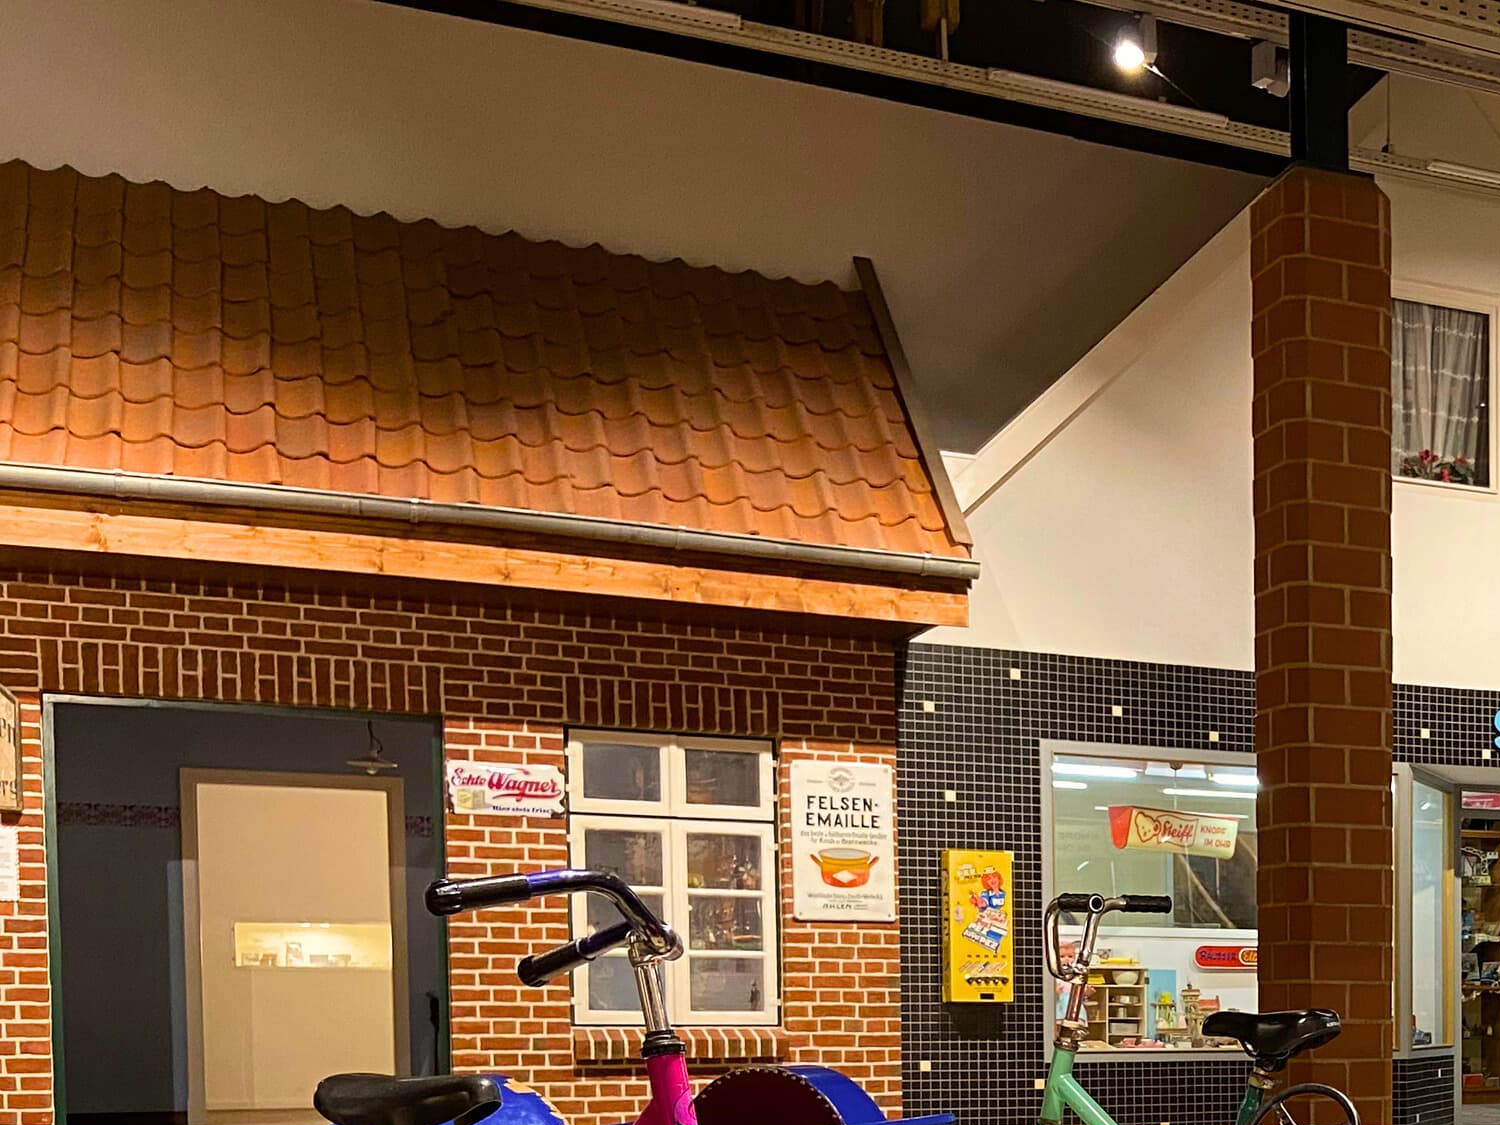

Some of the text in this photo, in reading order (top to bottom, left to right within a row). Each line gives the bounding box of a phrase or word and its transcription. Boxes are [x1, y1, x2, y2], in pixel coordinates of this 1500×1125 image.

[487, 771, 562, 802] Wagner
[806, 811, 880, 829] EMAILLE
[1200, 825, 1228, 835] KNOPF
[1161, 820, 1194, 843] Steiff
